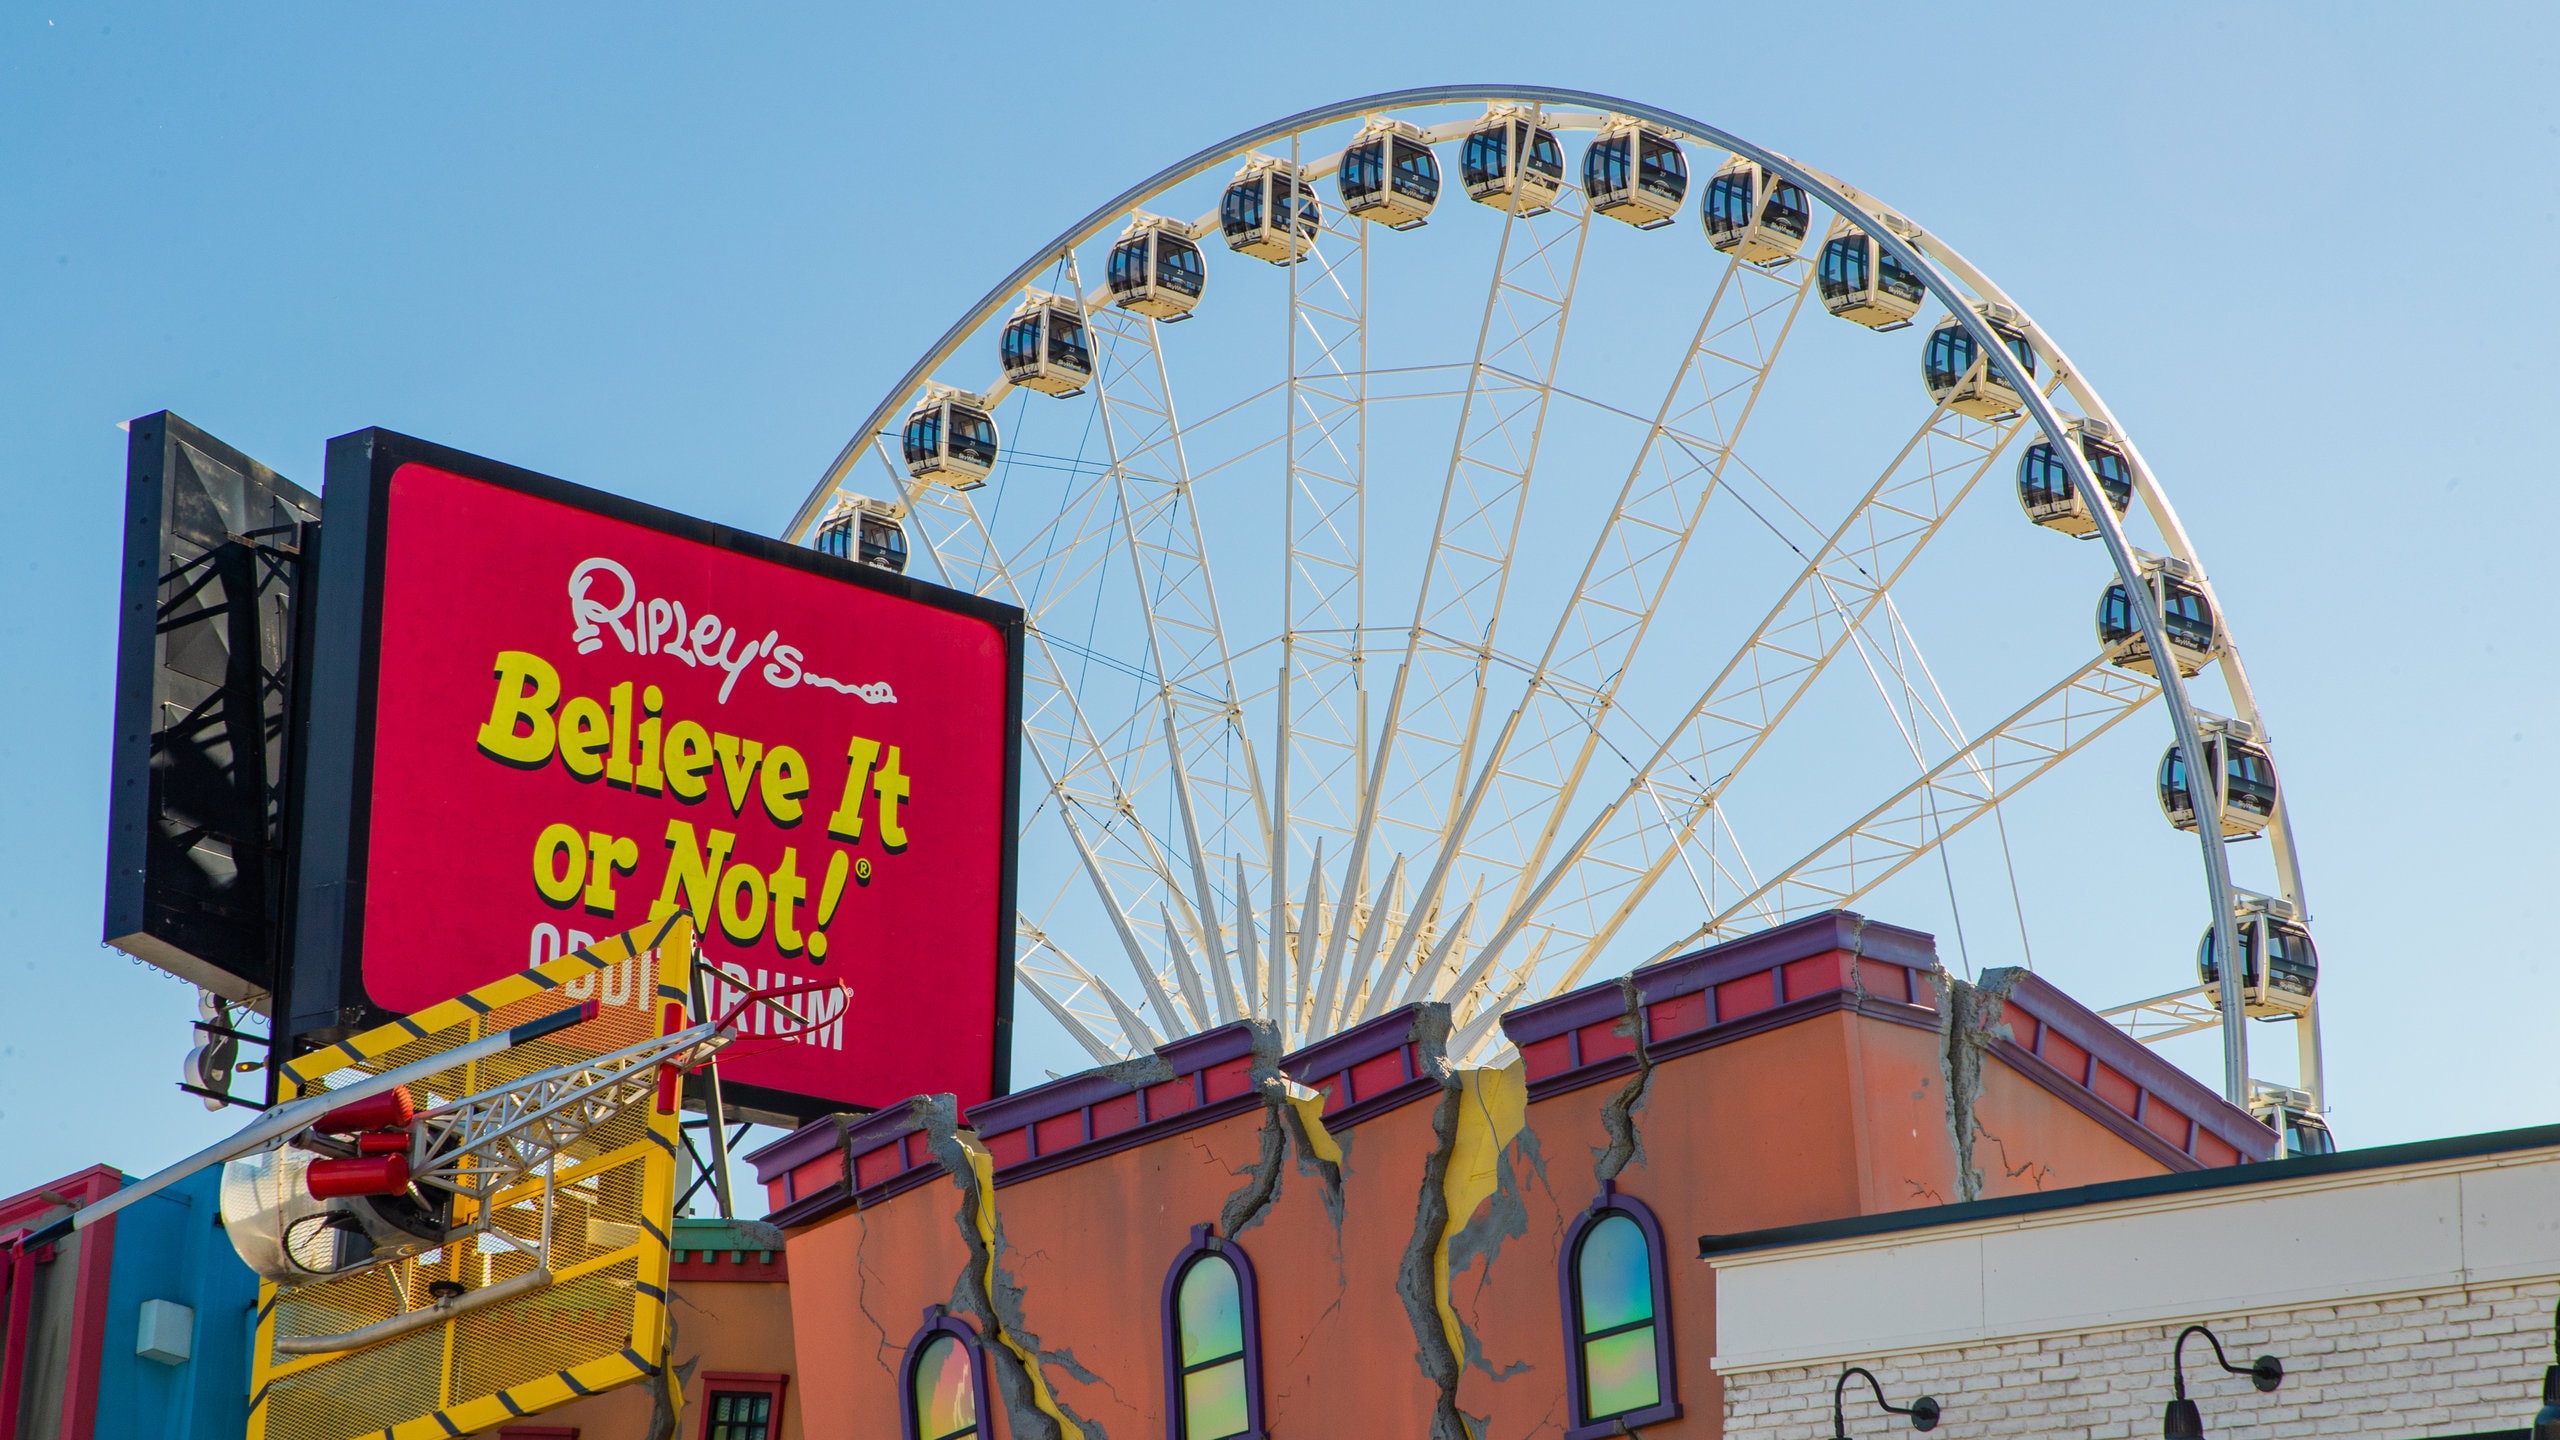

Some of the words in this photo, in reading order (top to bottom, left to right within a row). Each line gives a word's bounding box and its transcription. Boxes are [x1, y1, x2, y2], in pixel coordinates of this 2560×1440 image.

[1166, 282, 1190, 294] SkyWheel
[1888, 286, 1912, 299] SkyWheel
[2174, 636, 2198, 648] SkyWheel
[477, 650, 809, 829] Believe
[827, 735, 911, 854] It
[533, 822, 639, 918] or
